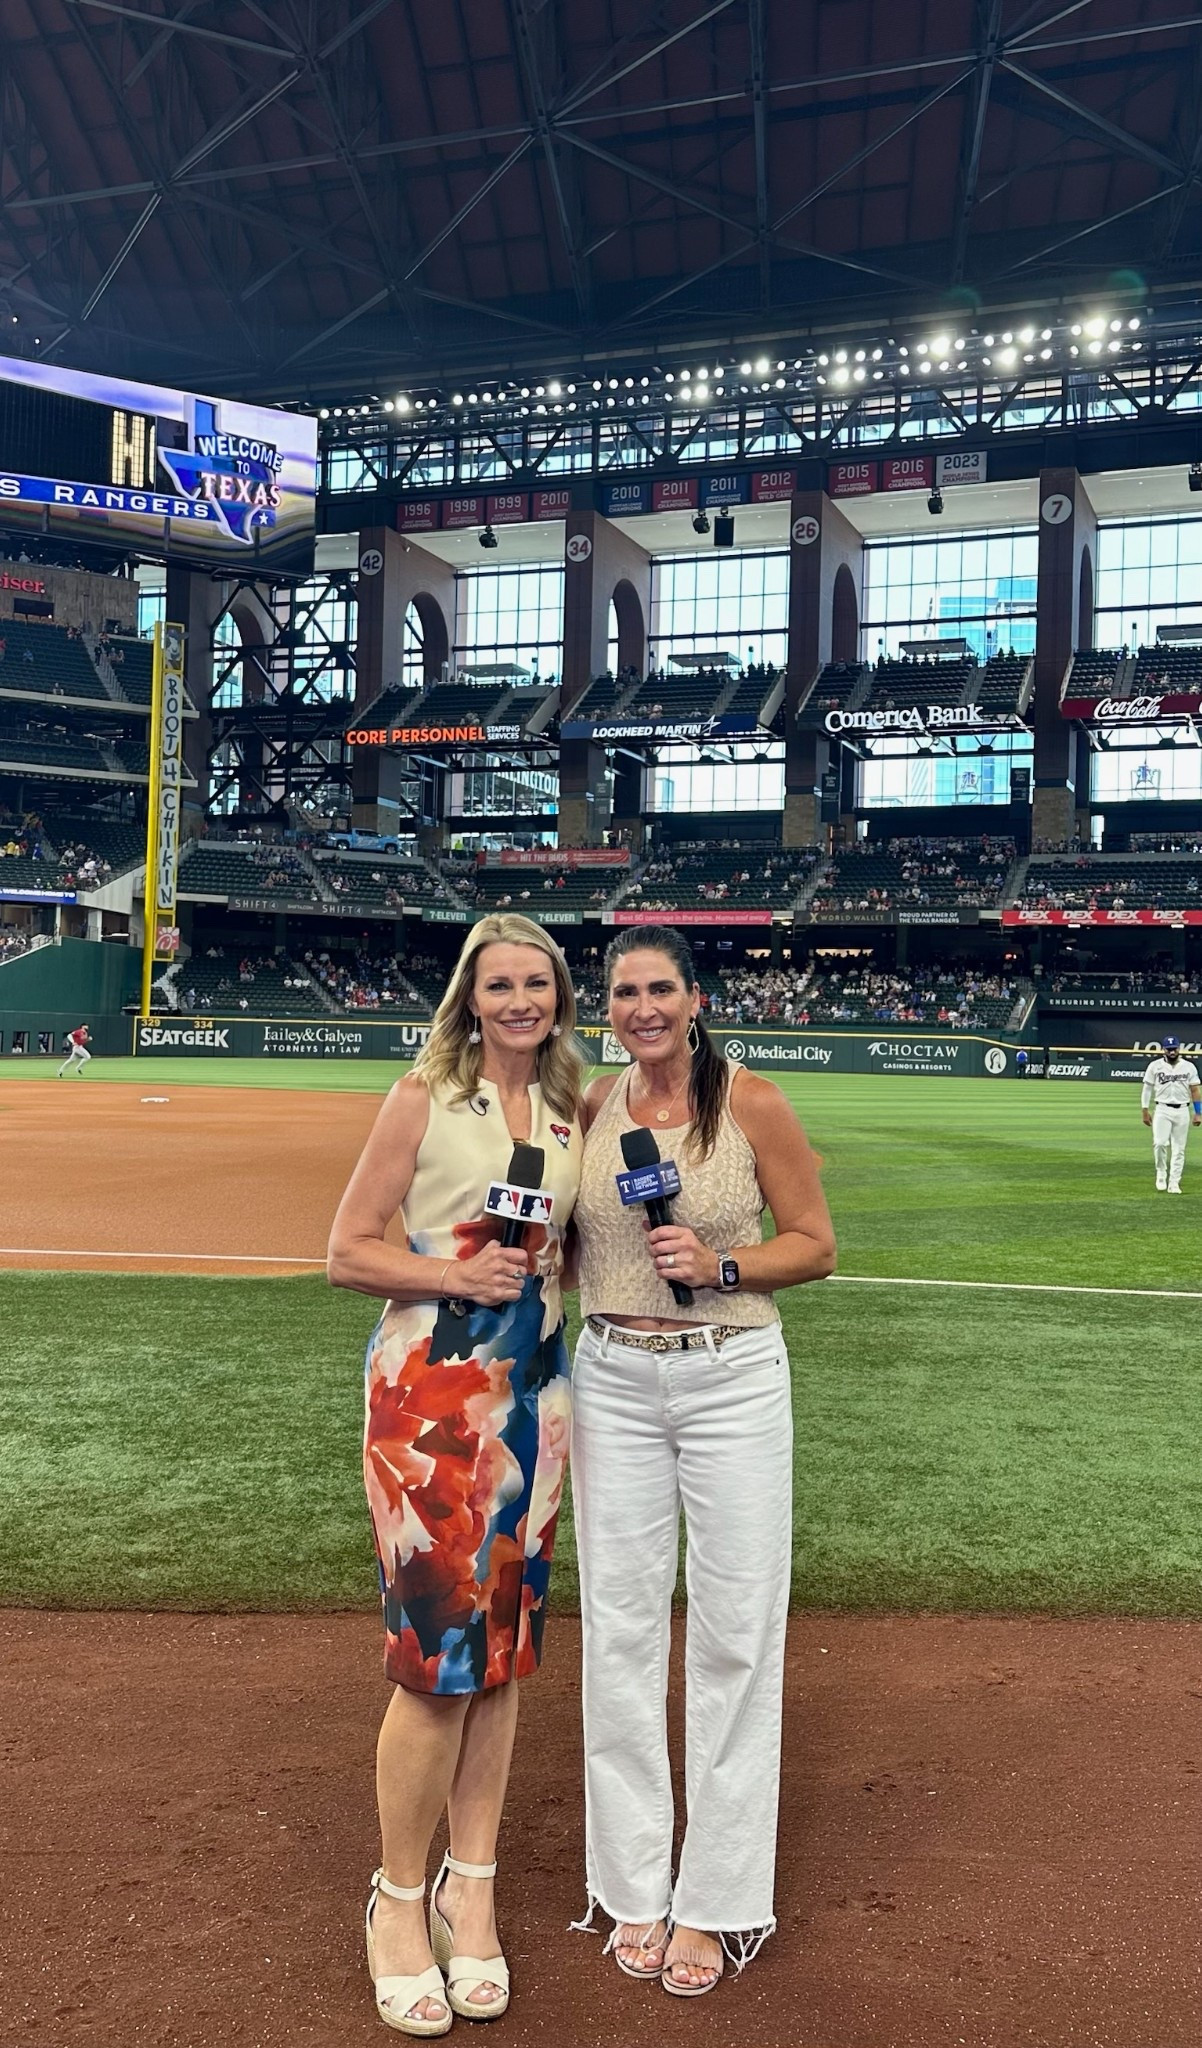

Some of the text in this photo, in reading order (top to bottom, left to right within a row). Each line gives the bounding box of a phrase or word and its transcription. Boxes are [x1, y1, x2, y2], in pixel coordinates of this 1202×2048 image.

[112, 410, 155, 488] H
[198, 436, 284, 472] WELCOME
[236, 460, 250, 475] TO
[892, 460, 924, 474] 2016
[943, 454, 980, 470] 2023
[838, 464, 869, 480] 2015
[710, 477, 737, 492] 2011
[761, 472, 791, 487] 2012
[888, 480, 926, 488] CHAMPIONS
[201, 472, 281, 508] TEXAS
[612, 486, 640, 500] 2010
[662, 482, 689, 496] 2011
[834, 485, 872, 493] CHAMPIONS
[54, 485, 209, 519] RANGERS
[450, 500, 476, 512] 1998
[494, 496, 522, 509] 1999
[541, 492, 568, 506] 2010
[658, 501, 692, 509] CHAMPIONS
[706, 496, 741, 505] CHAMPIONS
[404, 504, 431, 516] 1996
[608, 504, 642, 512] CHAMPIONS
[1051, 500, 1063, 518] 7
[794, 522, 816, 538] 26
[568, 540, 590, 556] 34
[362, 554, 380, 570] 42
[0, 572, 44, 593] iser
[164, 678, 179, 750] ROOT
[927, 703, 984, 724] Bank
[1094, 696, 1165, 719] Coca-Cola
[346, 726, 486, 744] CORE PERSONNEL
[486, 725, 520, 733] STAFFING
[487, 732, 520, 740] SERVICES
[592, 724, 702, 738] LOCKHEED MARTIN
[164, 762, 177, 781] 4
[160, 793, 176, 904] CHIKIN
[520, 854, 533, 862] HIT
[235, 899, 268, 909] SHIFT
[322, 904, 353, 914] SHIFT
[1018, 911, 1050, 920] DEX
[1062, 911, 1095, 920] DEX
[1106, 911, 1140, 920] DEX
[1152, 911, 1186, 920] DEX
[140, 1028, 230, 1048] SEATGEEK
[584, 1030, 601, 1038] 372
[263, 1045, 318, 1053] ATORNEYS
[748, 1045, 832, 1064] Medical City
[876, 1042, 959, 1058] CHOCTAW
[620, 1180, 630, 1193] T
